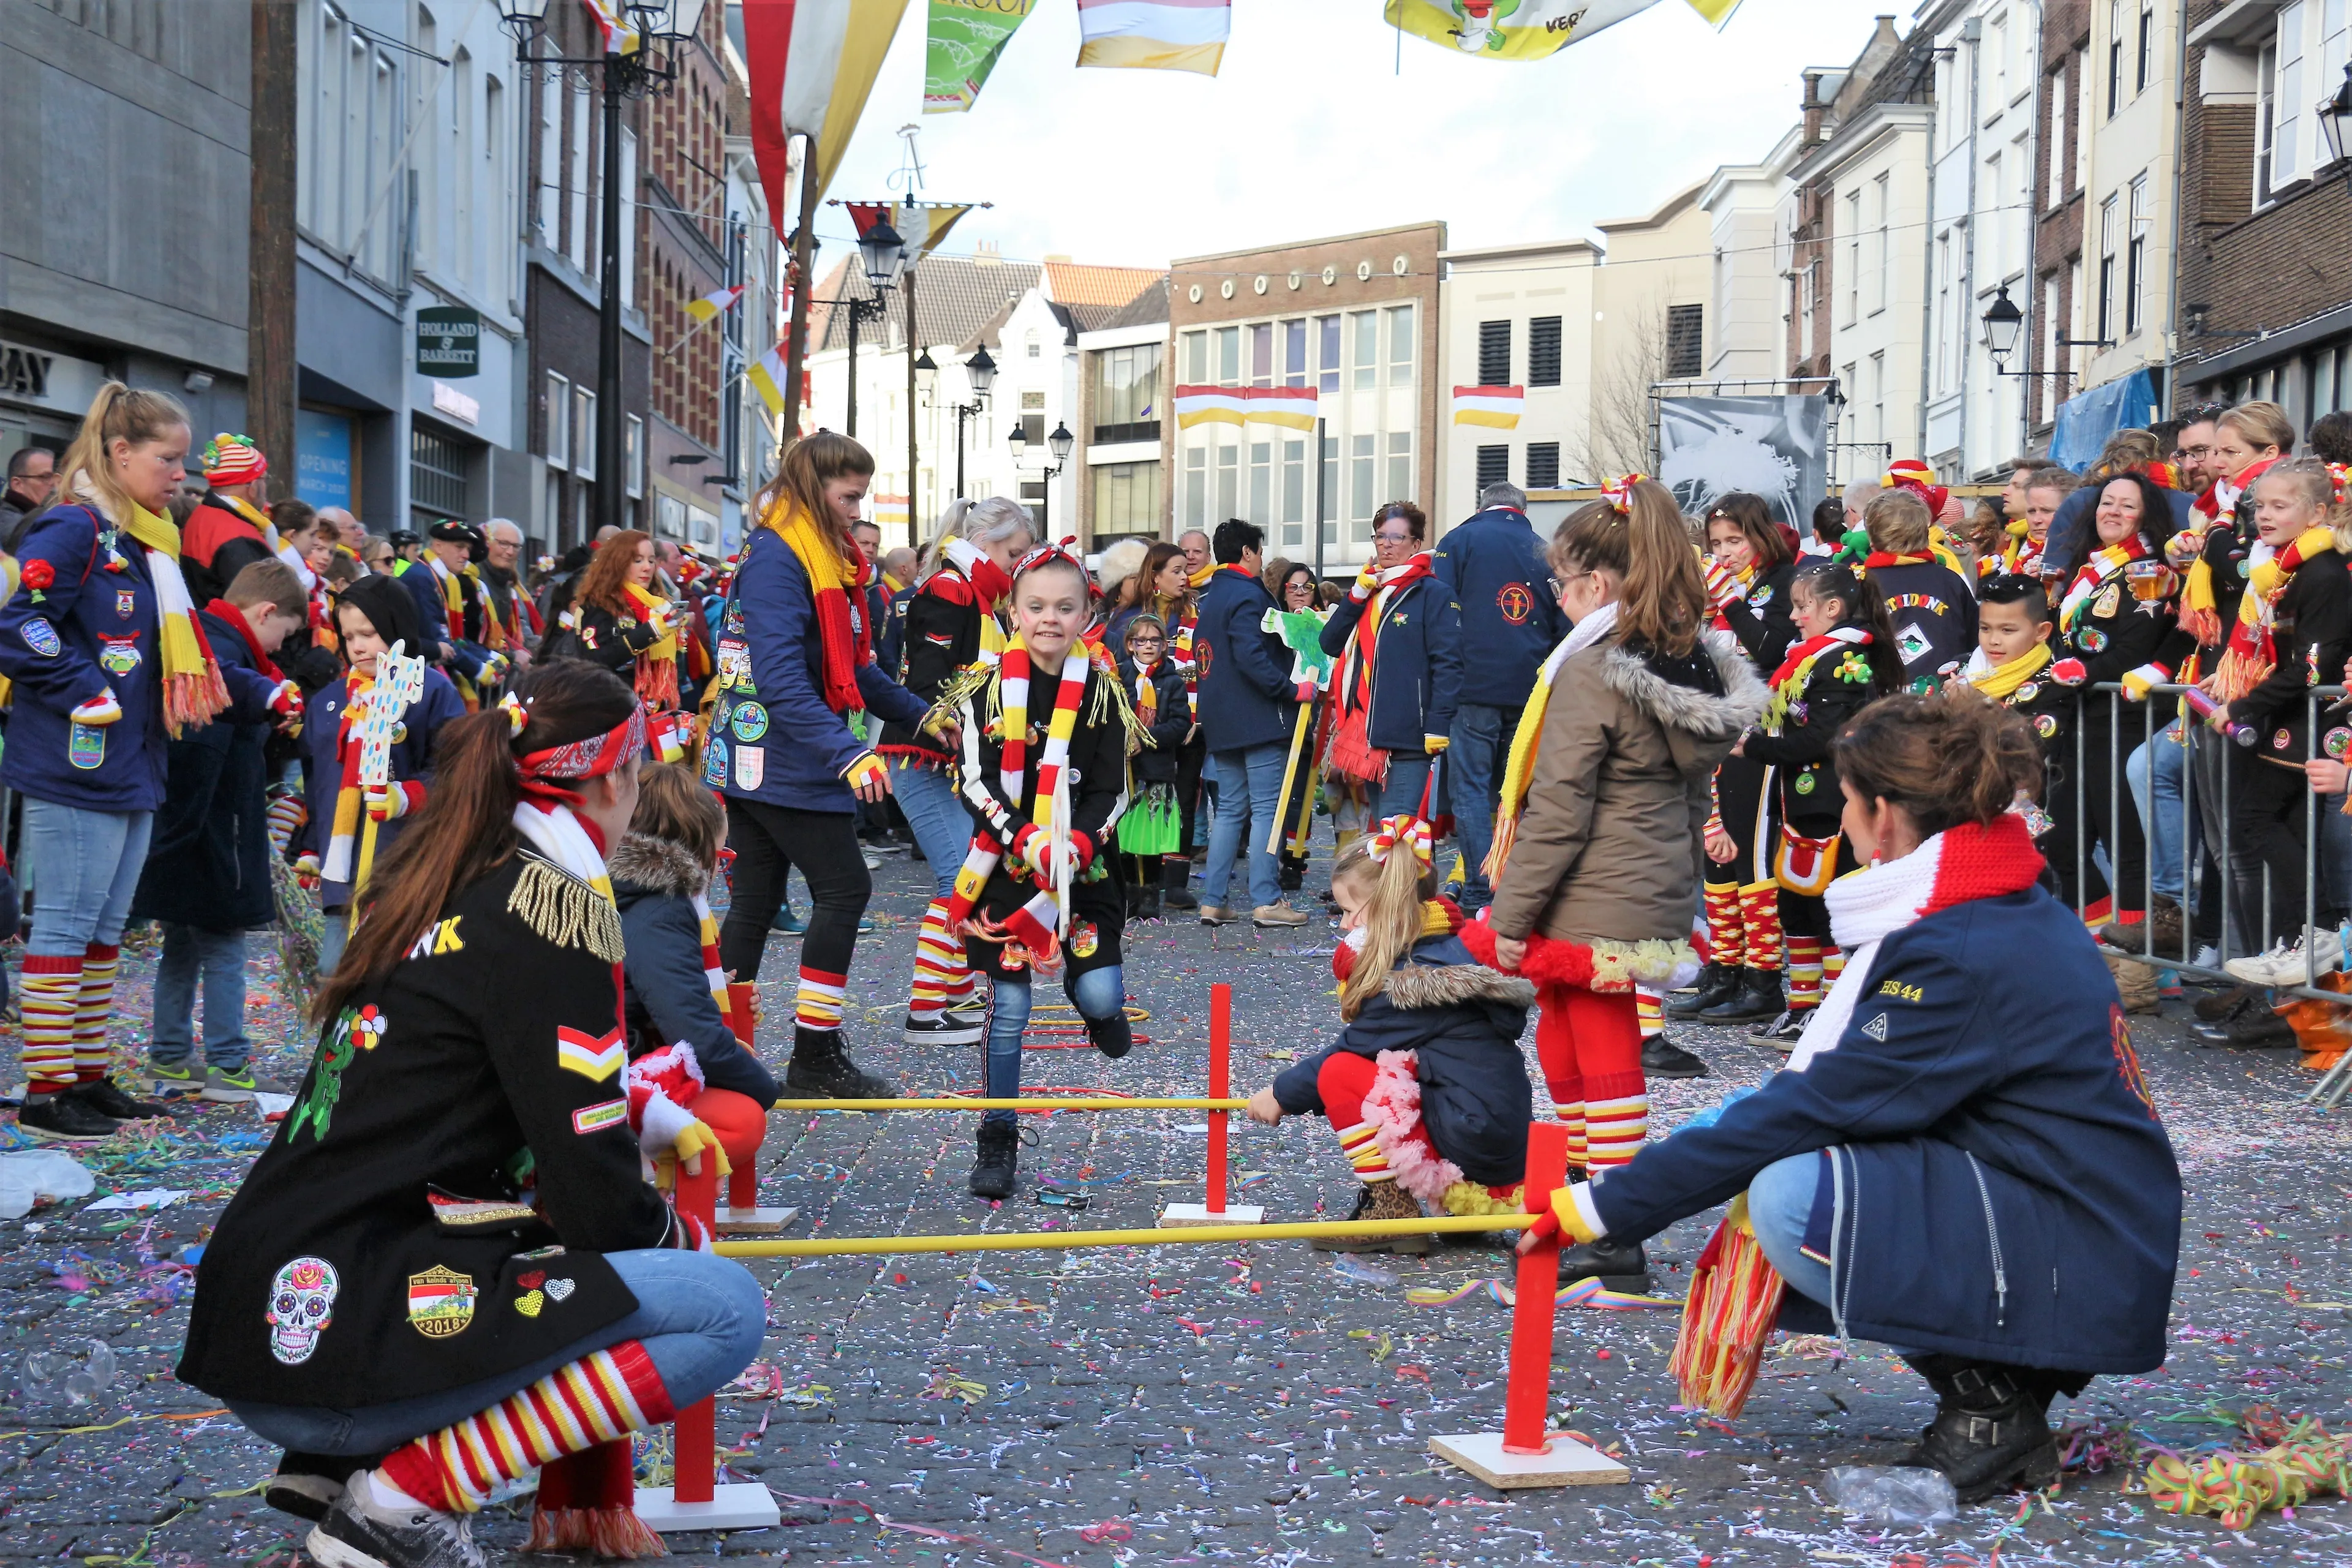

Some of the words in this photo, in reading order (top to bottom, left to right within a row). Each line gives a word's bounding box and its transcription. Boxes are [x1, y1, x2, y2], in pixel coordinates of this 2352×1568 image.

[418, 322, 477, 337] HOLLAND
[420, 349, 476, 364] BARRETT
[300, 454, 347, 475] OPENING
[424, 1317, 461, 1334] 2018
